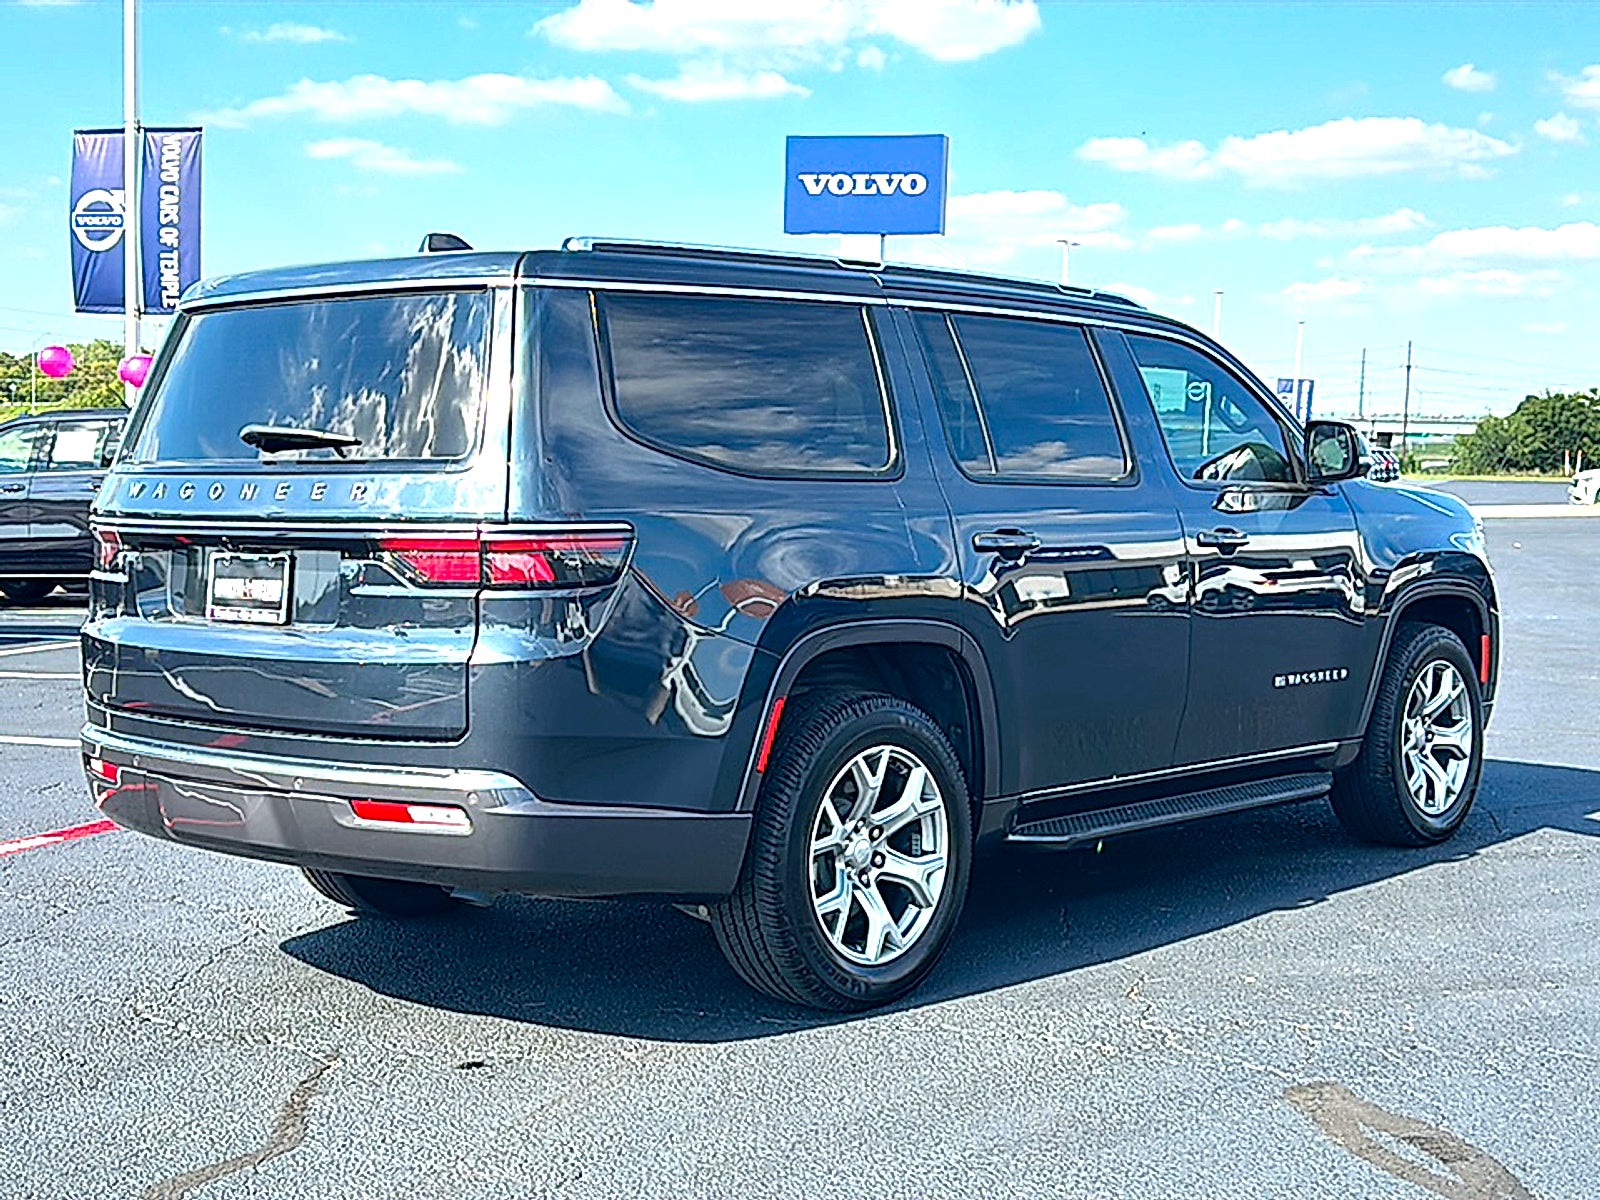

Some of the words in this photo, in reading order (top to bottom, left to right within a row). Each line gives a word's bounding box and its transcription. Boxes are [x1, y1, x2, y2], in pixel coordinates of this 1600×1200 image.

[160, 134, 182, 183] VOLVO
[798, 173, 927, 195] VOLVO
[159, 185, 180, 225] CARS
[76, 216, 122, 226] VOLVO
[159, 227, 180, 248] OF
[159, 251, 181, 310] TEMPLE
[128, 481, 368, 501] WAGONEER
